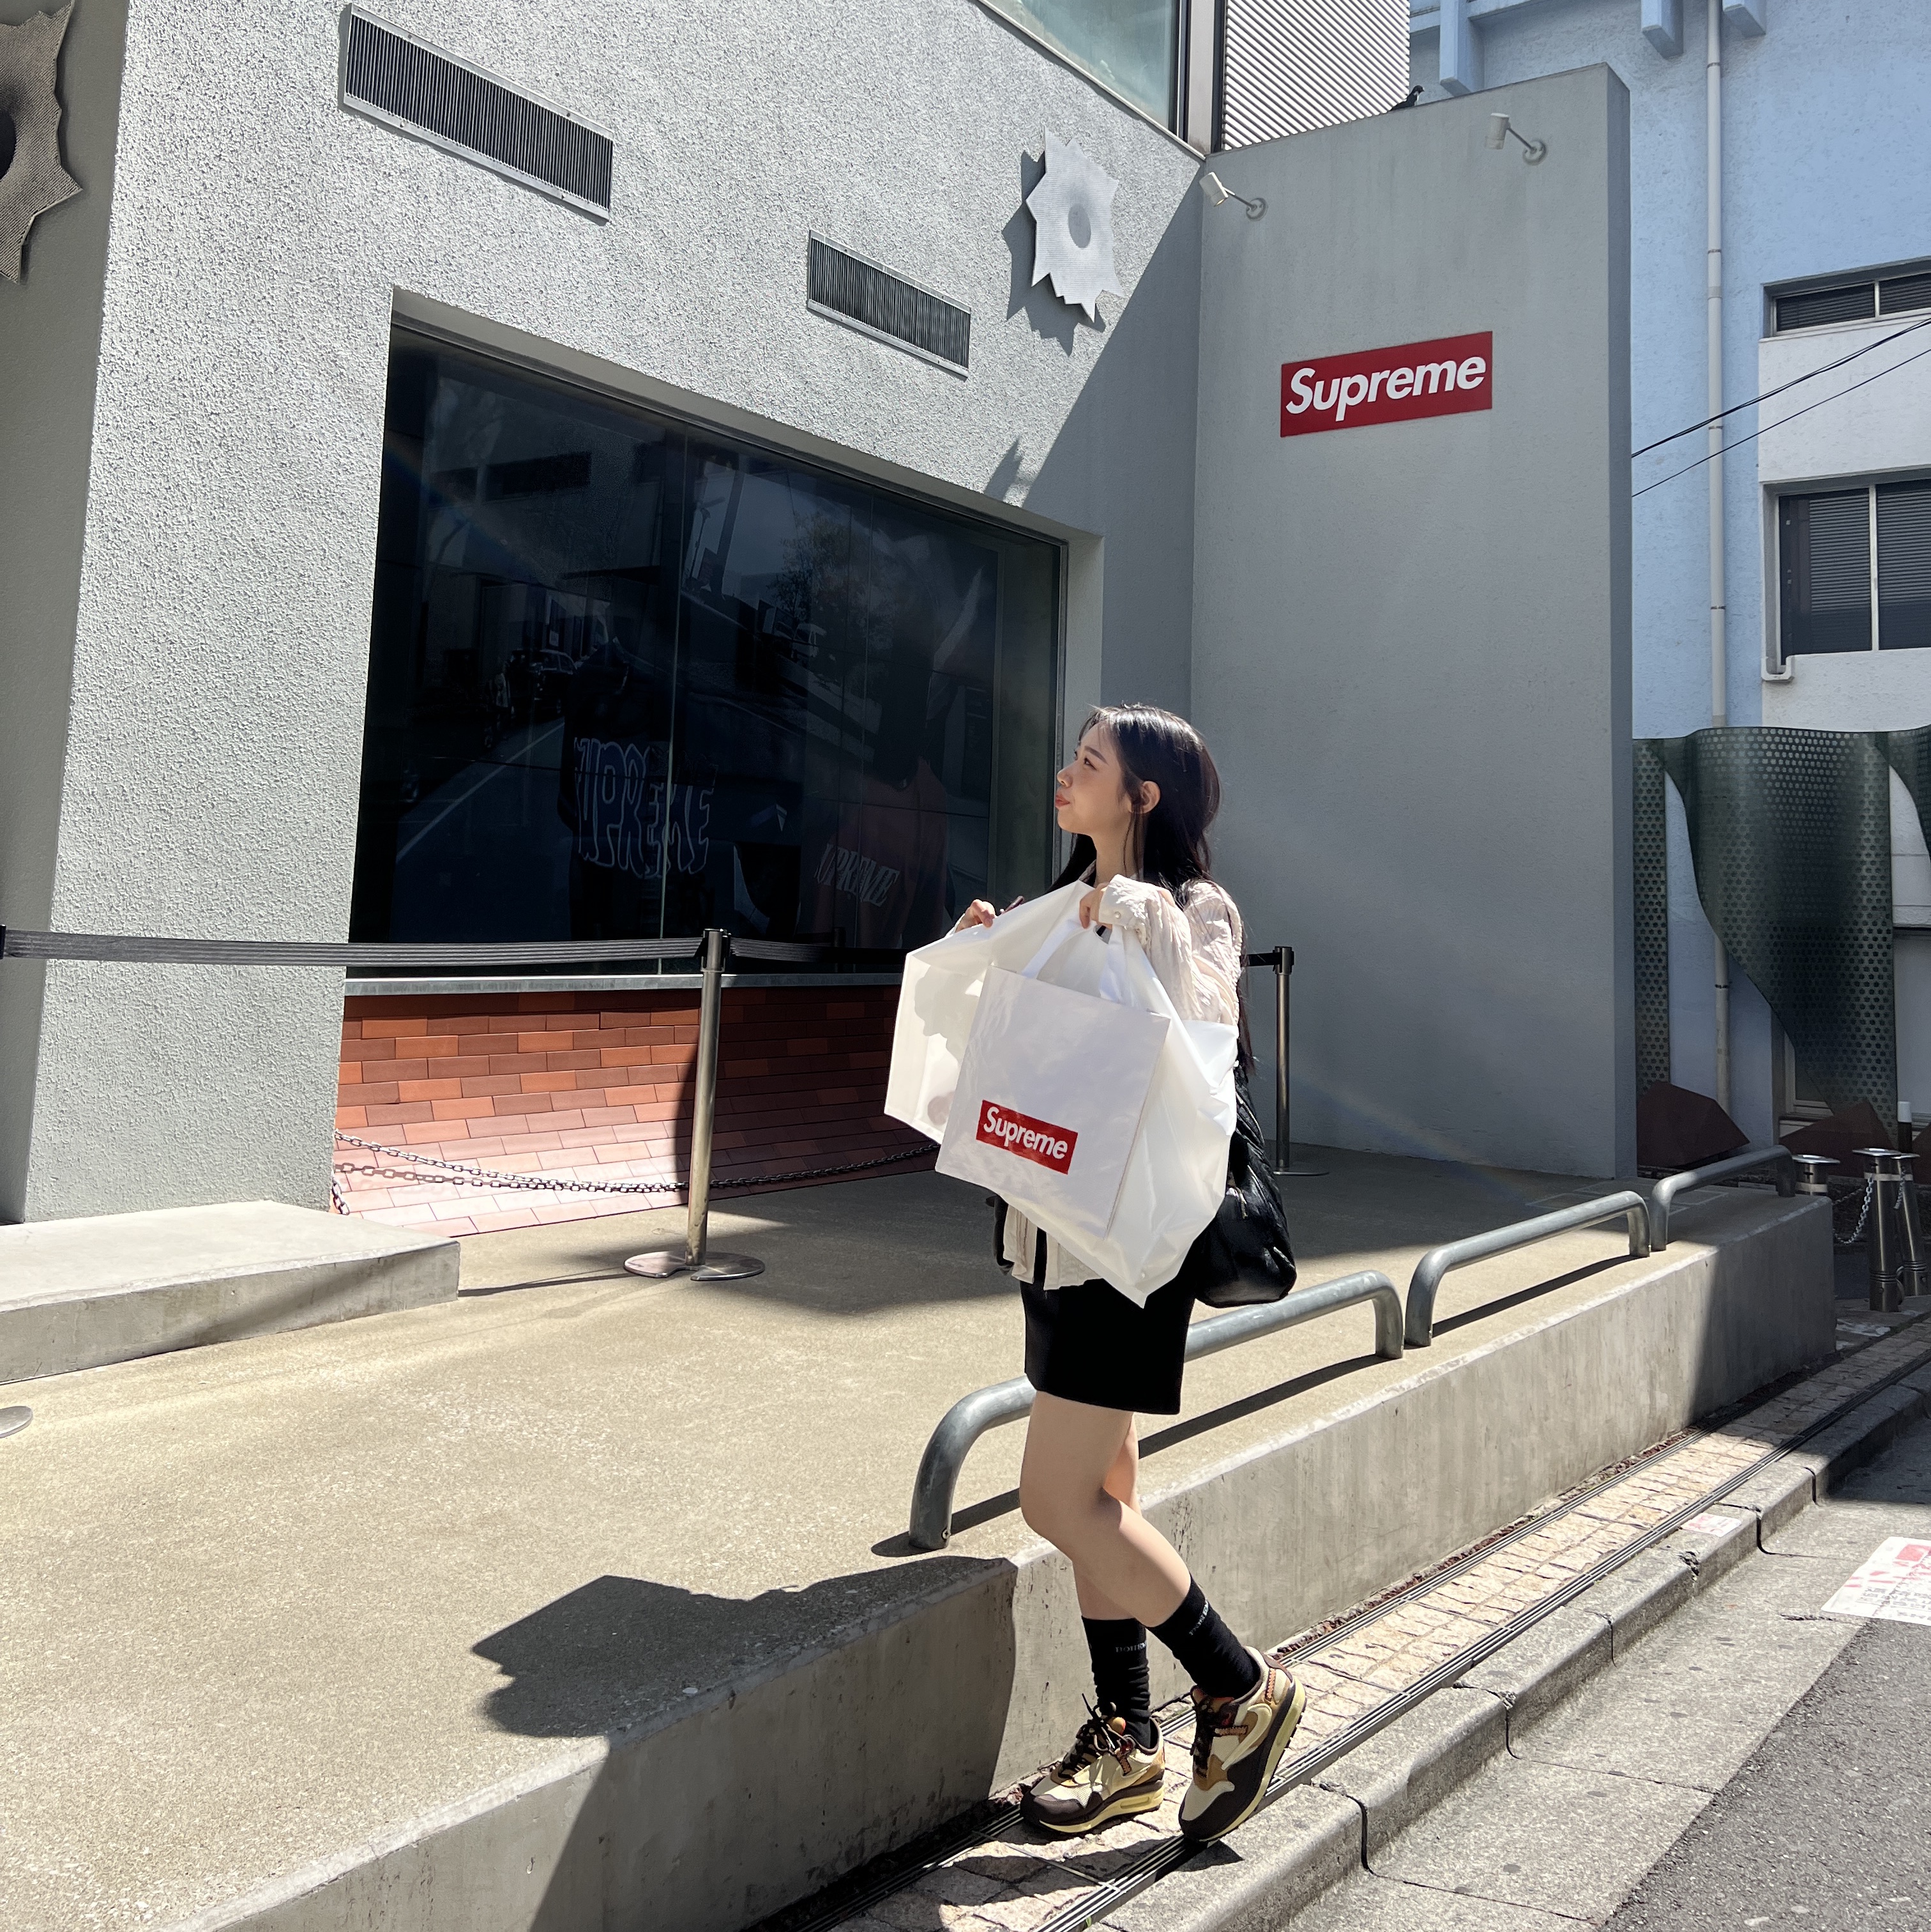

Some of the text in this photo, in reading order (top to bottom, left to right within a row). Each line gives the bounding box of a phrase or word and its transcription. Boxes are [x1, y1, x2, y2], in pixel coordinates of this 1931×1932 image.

[1285, 356, 1487, 422] Supreme
[575, 737, 718, 879] UPREME
[814, 843, 900, 907] UPREME
[983, 1106, 1068, 1160] Supreme
